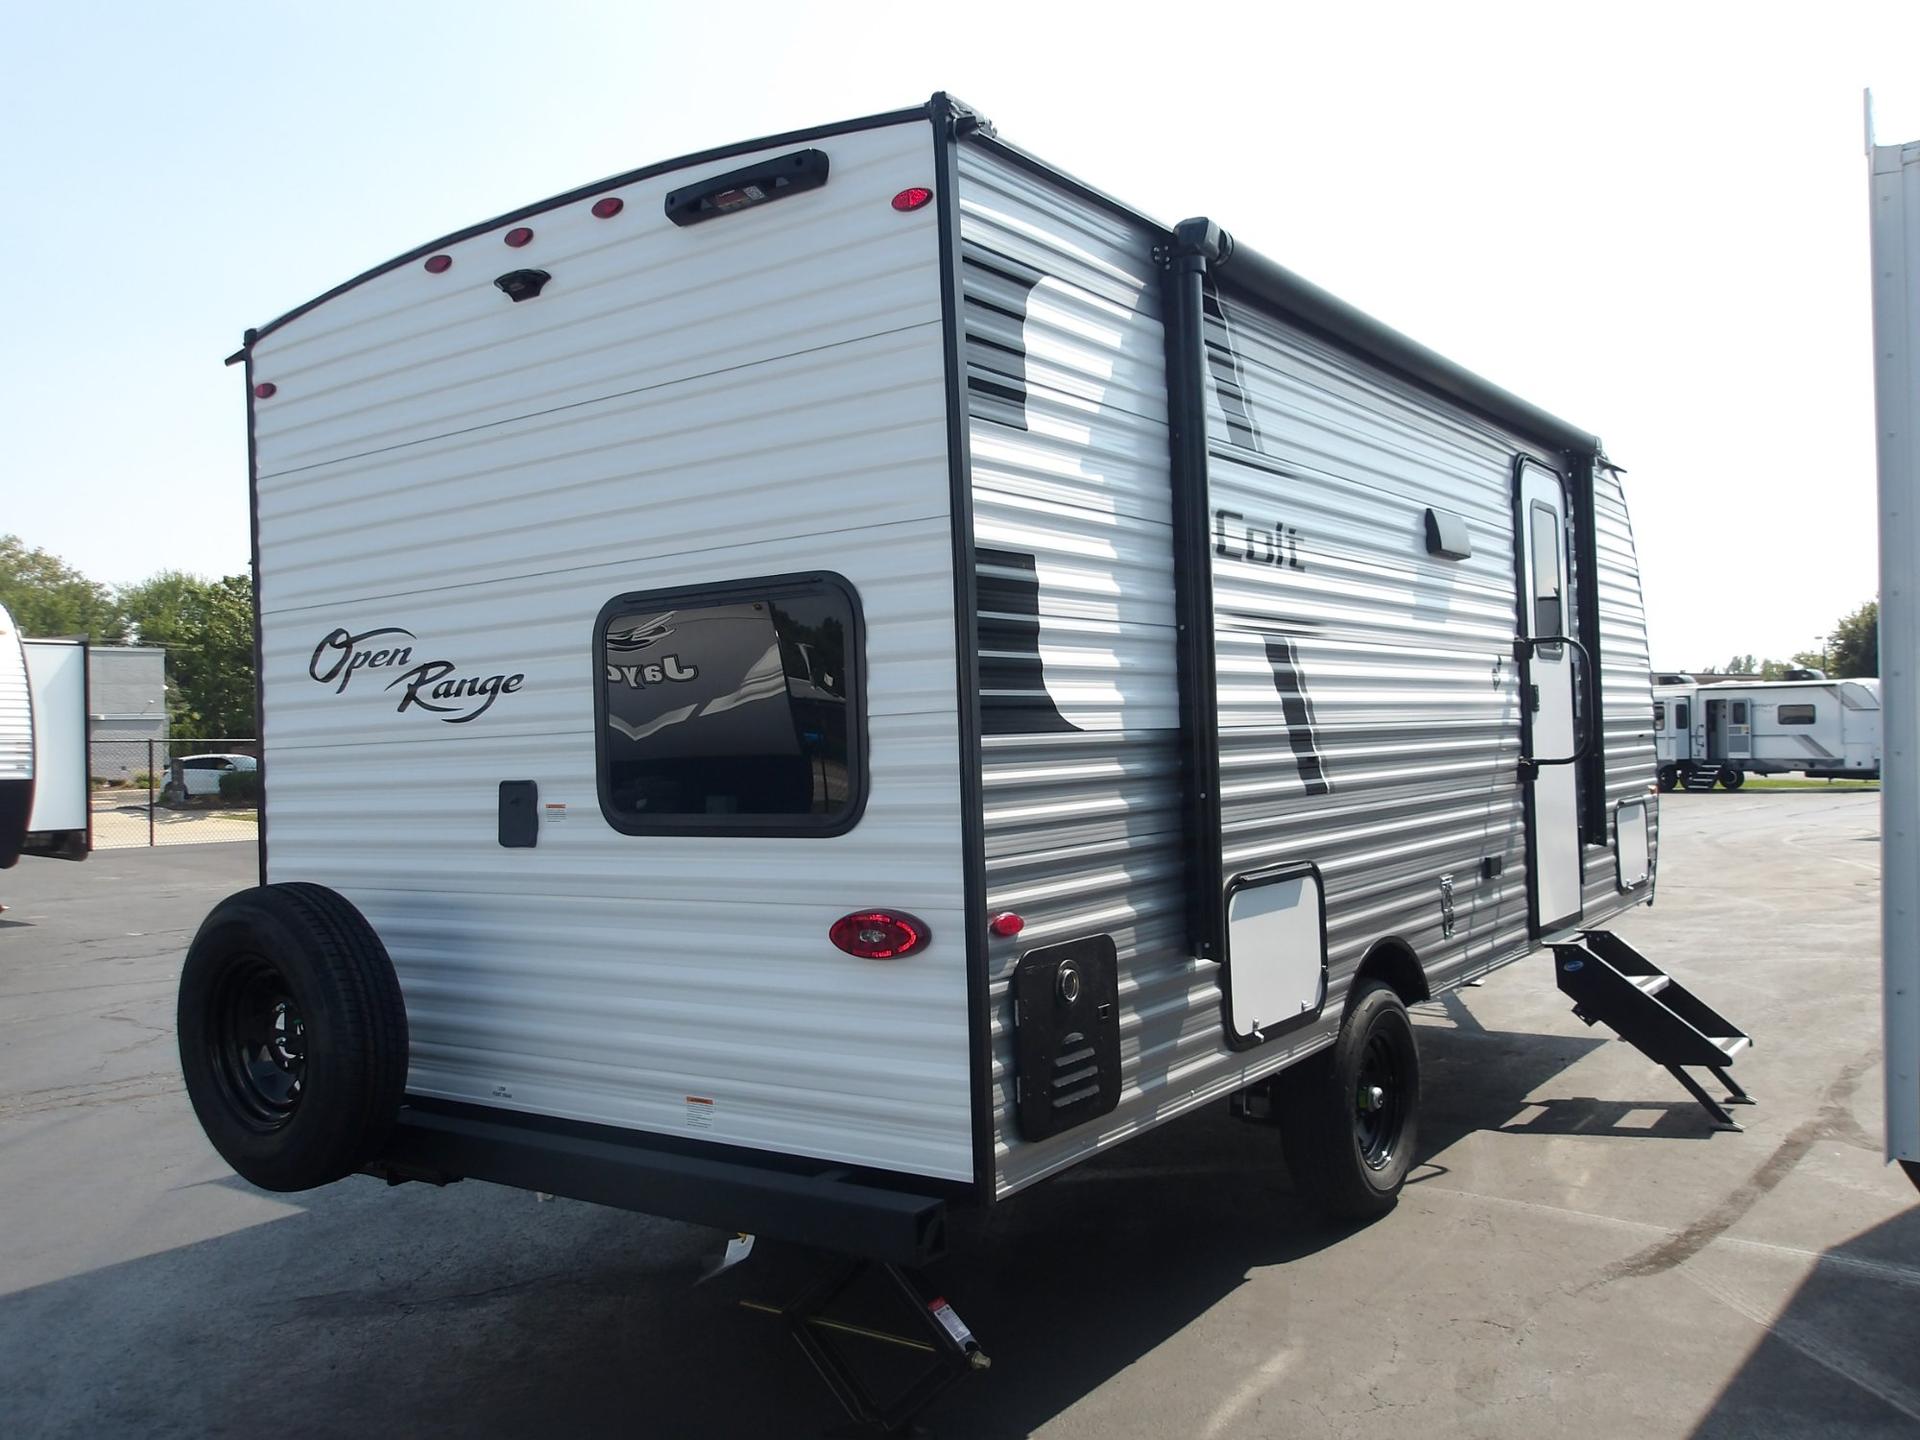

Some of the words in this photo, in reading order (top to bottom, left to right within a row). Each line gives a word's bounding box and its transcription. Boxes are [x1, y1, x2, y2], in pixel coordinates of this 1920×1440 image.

[1215, 509, 1305, 572] Colt
[309, 627, 417, 694] Open
[384, 660, 525, 724] Range
